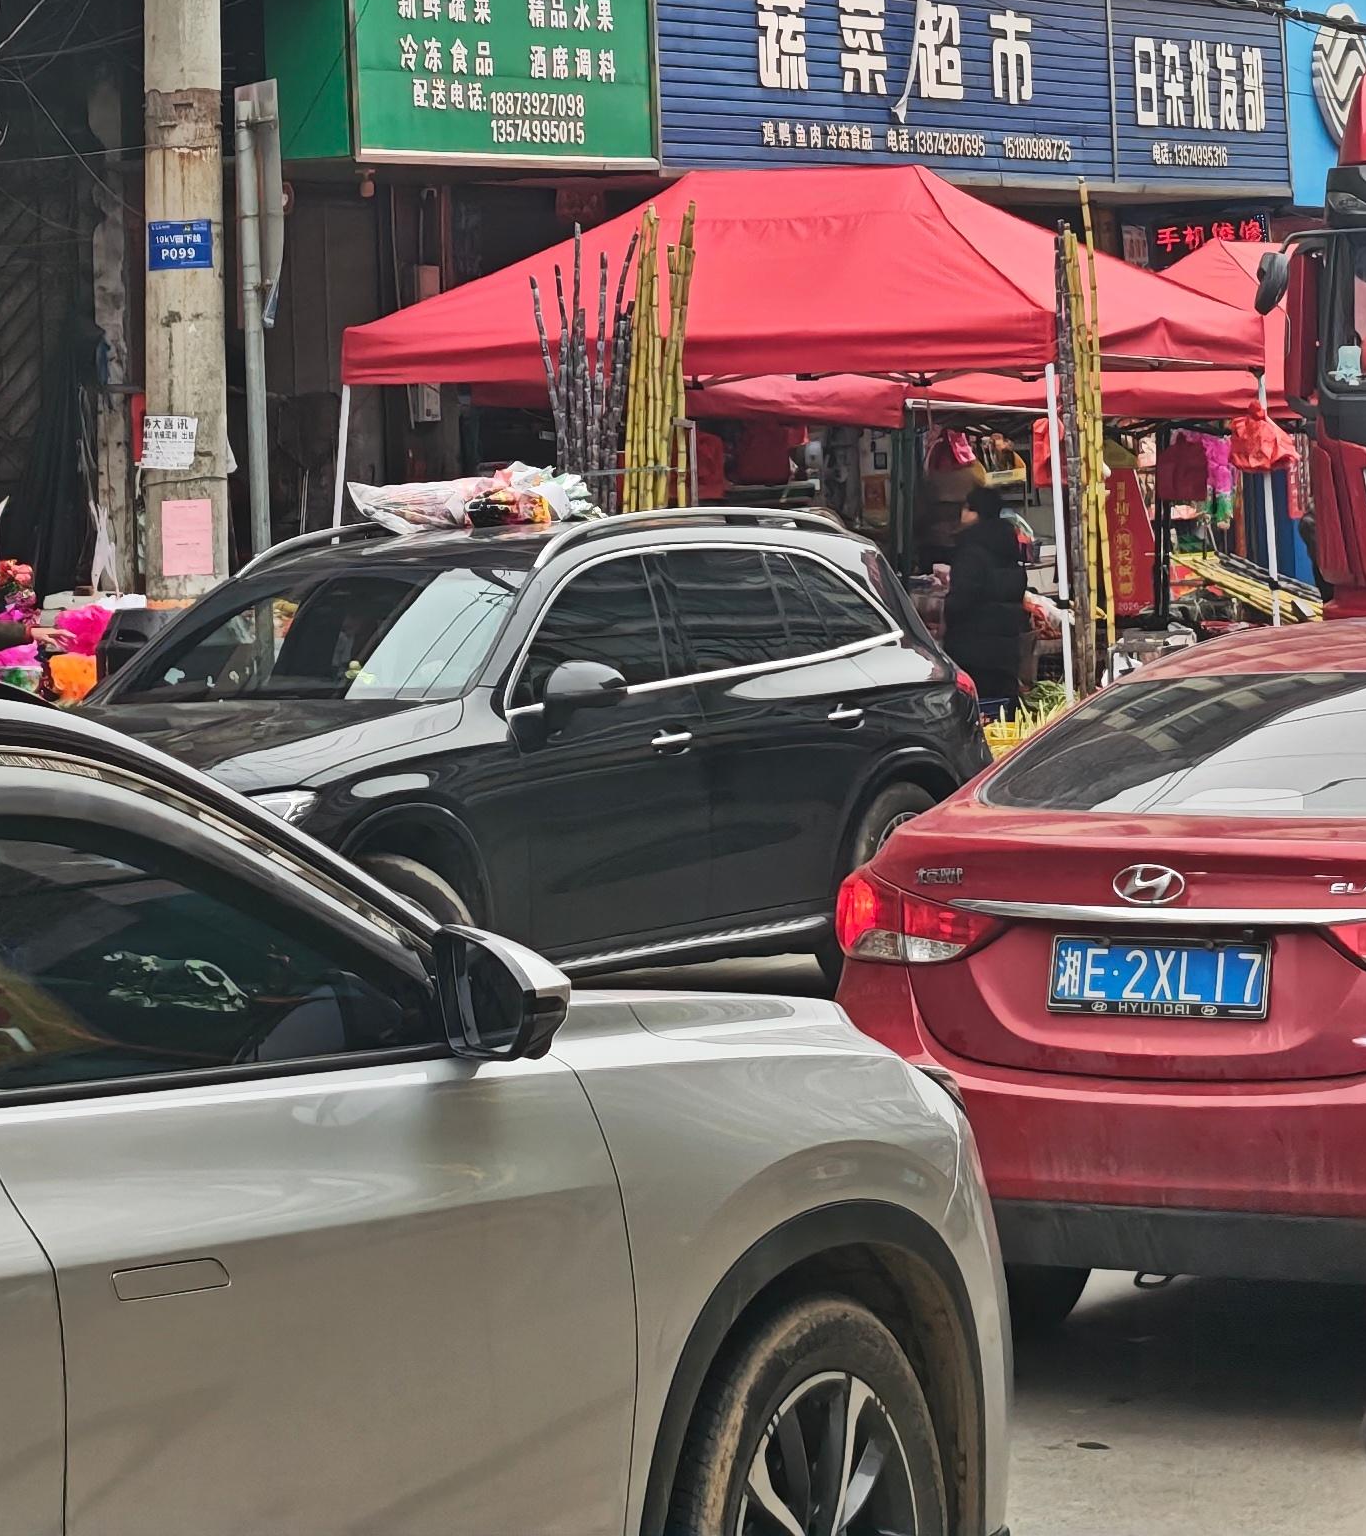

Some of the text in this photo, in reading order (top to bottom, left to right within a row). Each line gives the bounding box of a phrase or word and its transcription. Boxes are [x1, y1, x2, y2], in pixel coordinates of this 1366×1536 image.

[399, 34, 616, 83] 冷冻食品 酒席调料
[1134, 37, 1266, 132] 日杂批发部
[490, 119, 586, 144] 13574995015
[1002, 136, 1072, 162] 15180988725
[1156, 218, 1263, 253] 手机维修
[161, 247, 196, 260] P099
[1117, 1002, 1191, 1015] HYUNDAI
